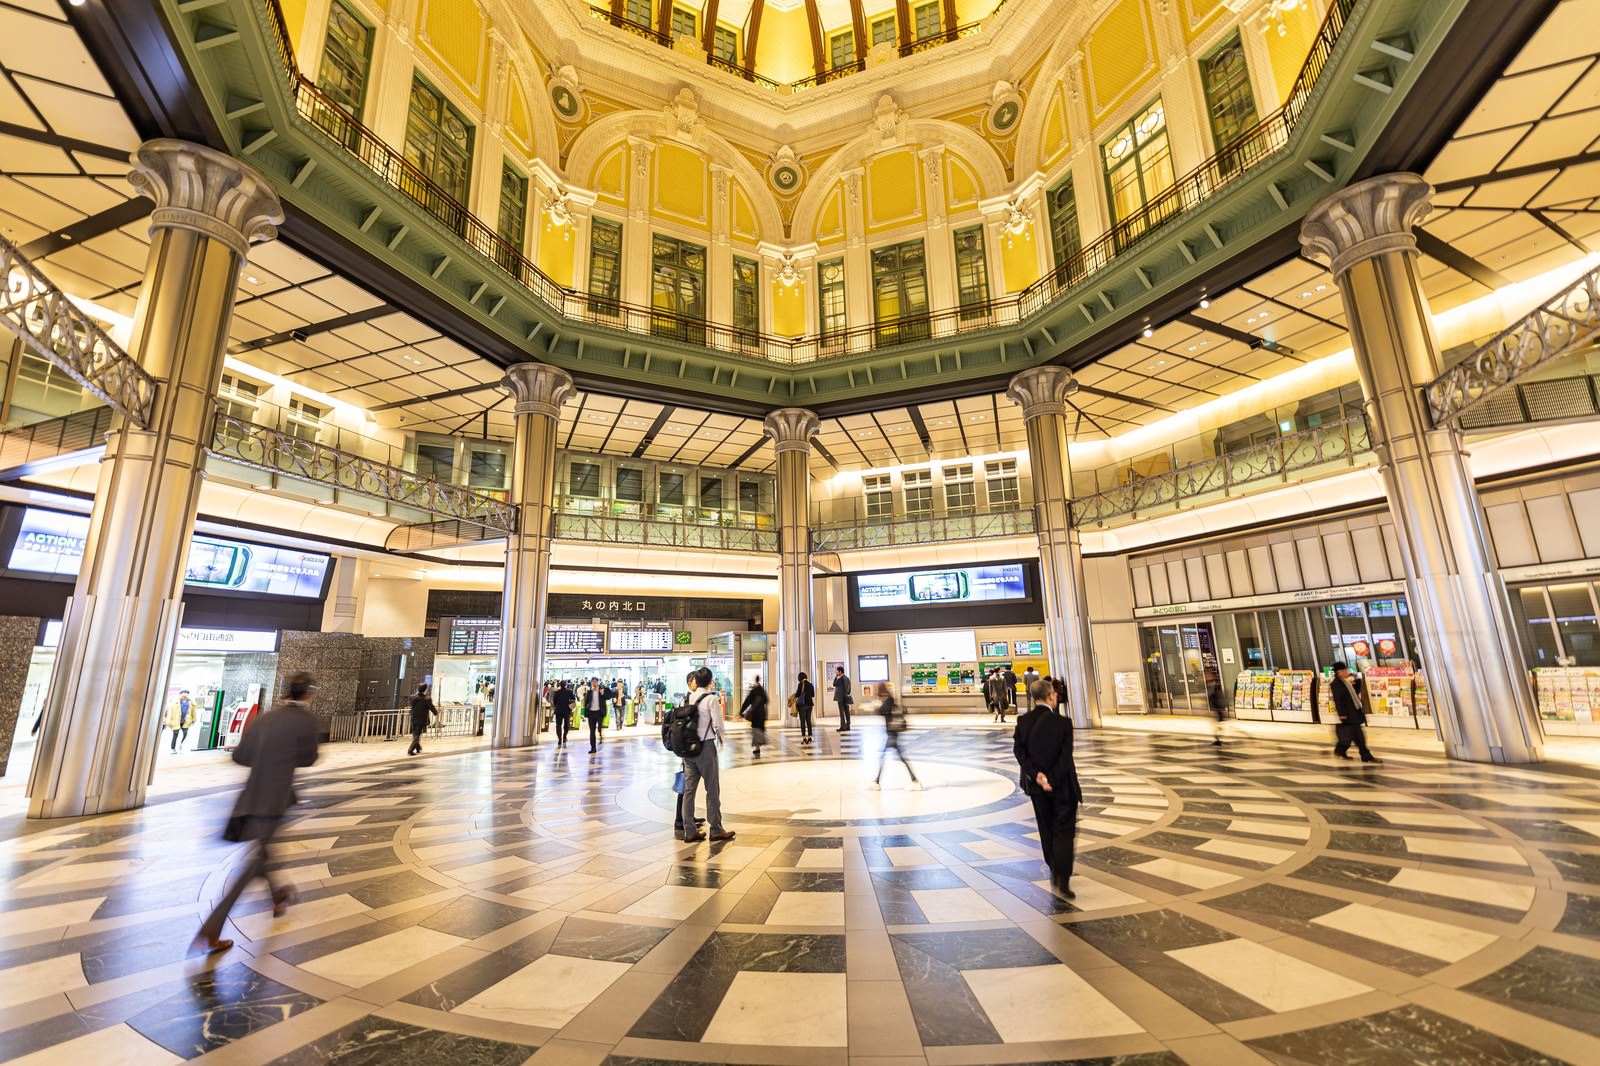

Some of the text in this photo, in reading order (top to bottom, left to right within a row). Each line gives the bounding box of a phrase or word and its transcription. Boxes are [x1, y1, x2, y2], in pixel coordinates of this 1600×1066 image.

[25, 532, 77, 547] ACTION
[582, 599, 646, 611] 丸の内北口
[1152, 605, 1187, 614] みどりの窓口
